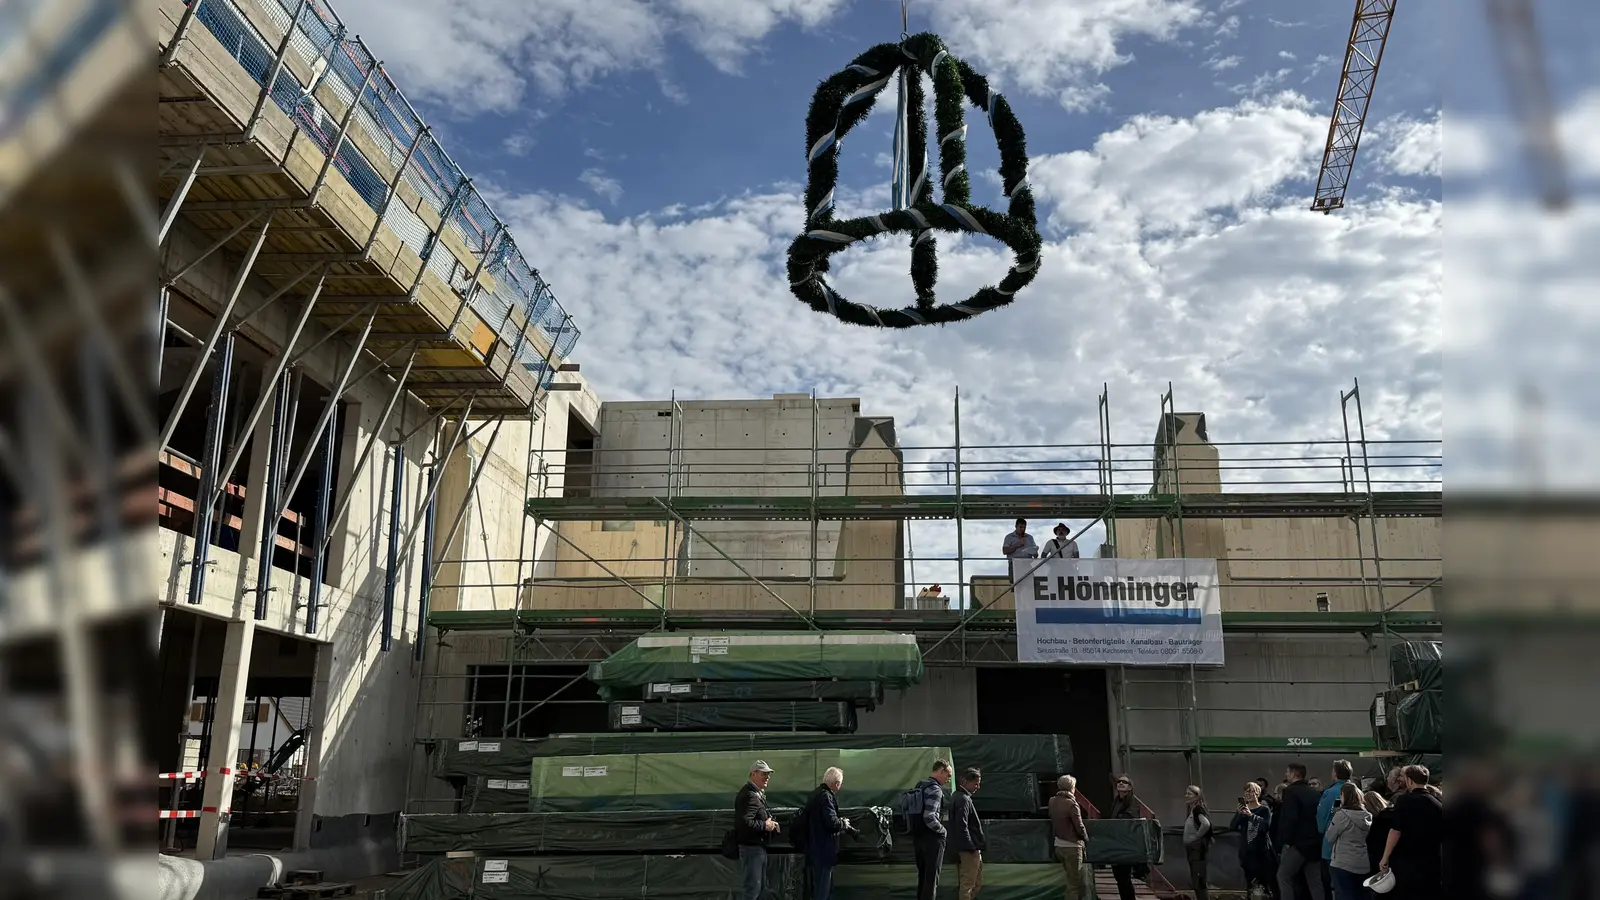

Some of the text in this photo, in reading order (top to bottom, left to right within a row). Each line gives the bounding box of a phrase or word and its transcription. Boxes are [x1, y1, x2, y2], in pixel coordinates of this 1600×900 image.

[1033, 576, 1199, 607] E.Hönninger
[1036, 637, 1068, 645] Hochbau
[1072, 637, 1126, 646] Betonfertigteile
